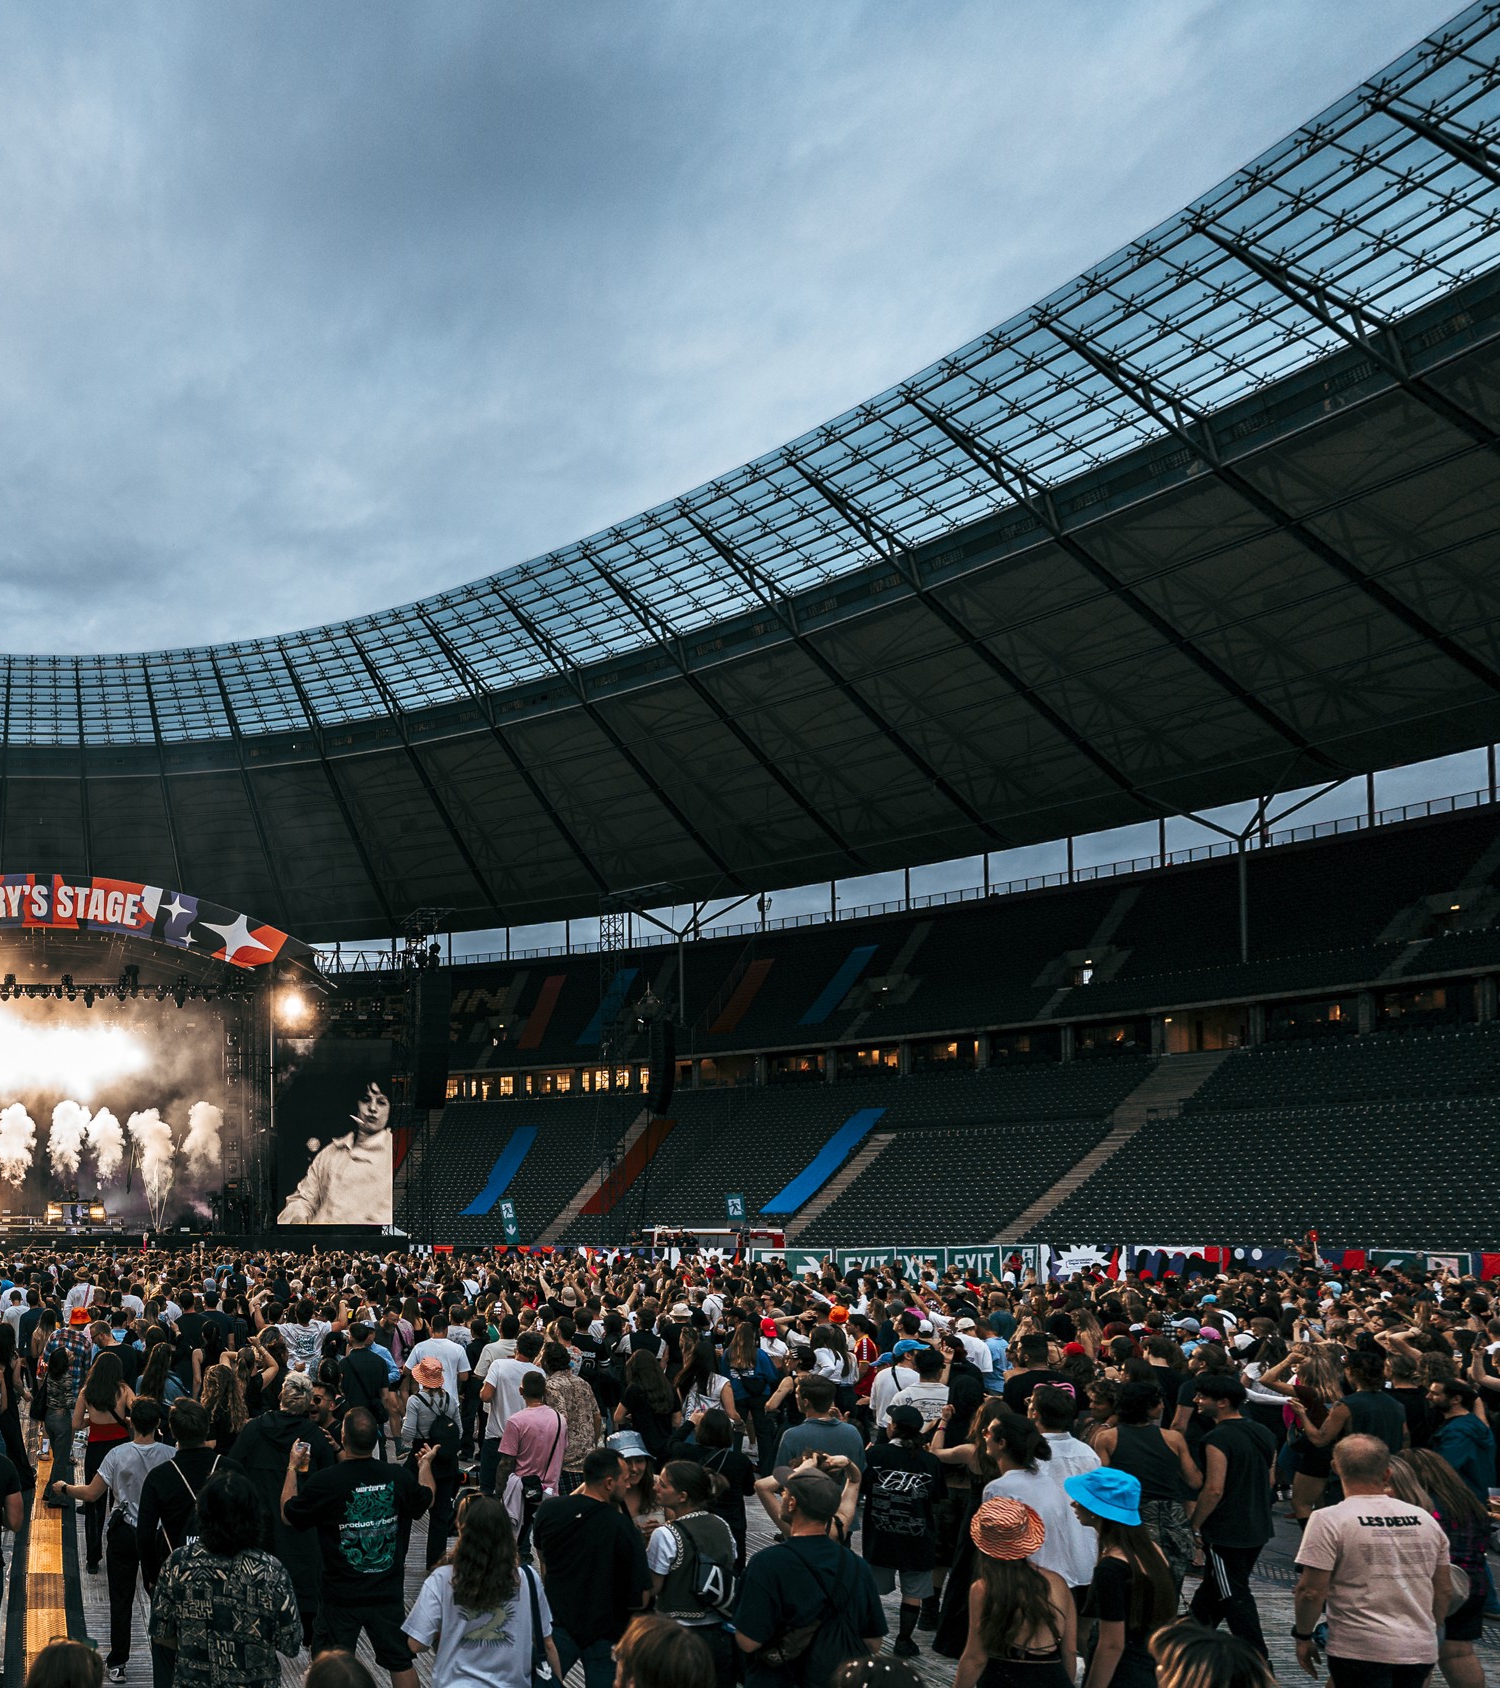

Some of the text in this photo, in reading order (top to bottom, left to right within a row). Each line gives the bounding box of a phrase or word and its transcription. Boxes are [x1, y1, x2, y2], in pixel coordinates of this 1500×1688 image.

[56, 885, 141, 926] STAGE
[896, 1255, 937, 1280] XI
[954, 1253, 994, 1279] EXIT
[338, 1520, 374, 1531] product
[1357, 1515, 1422, 1527] LES DEUX
